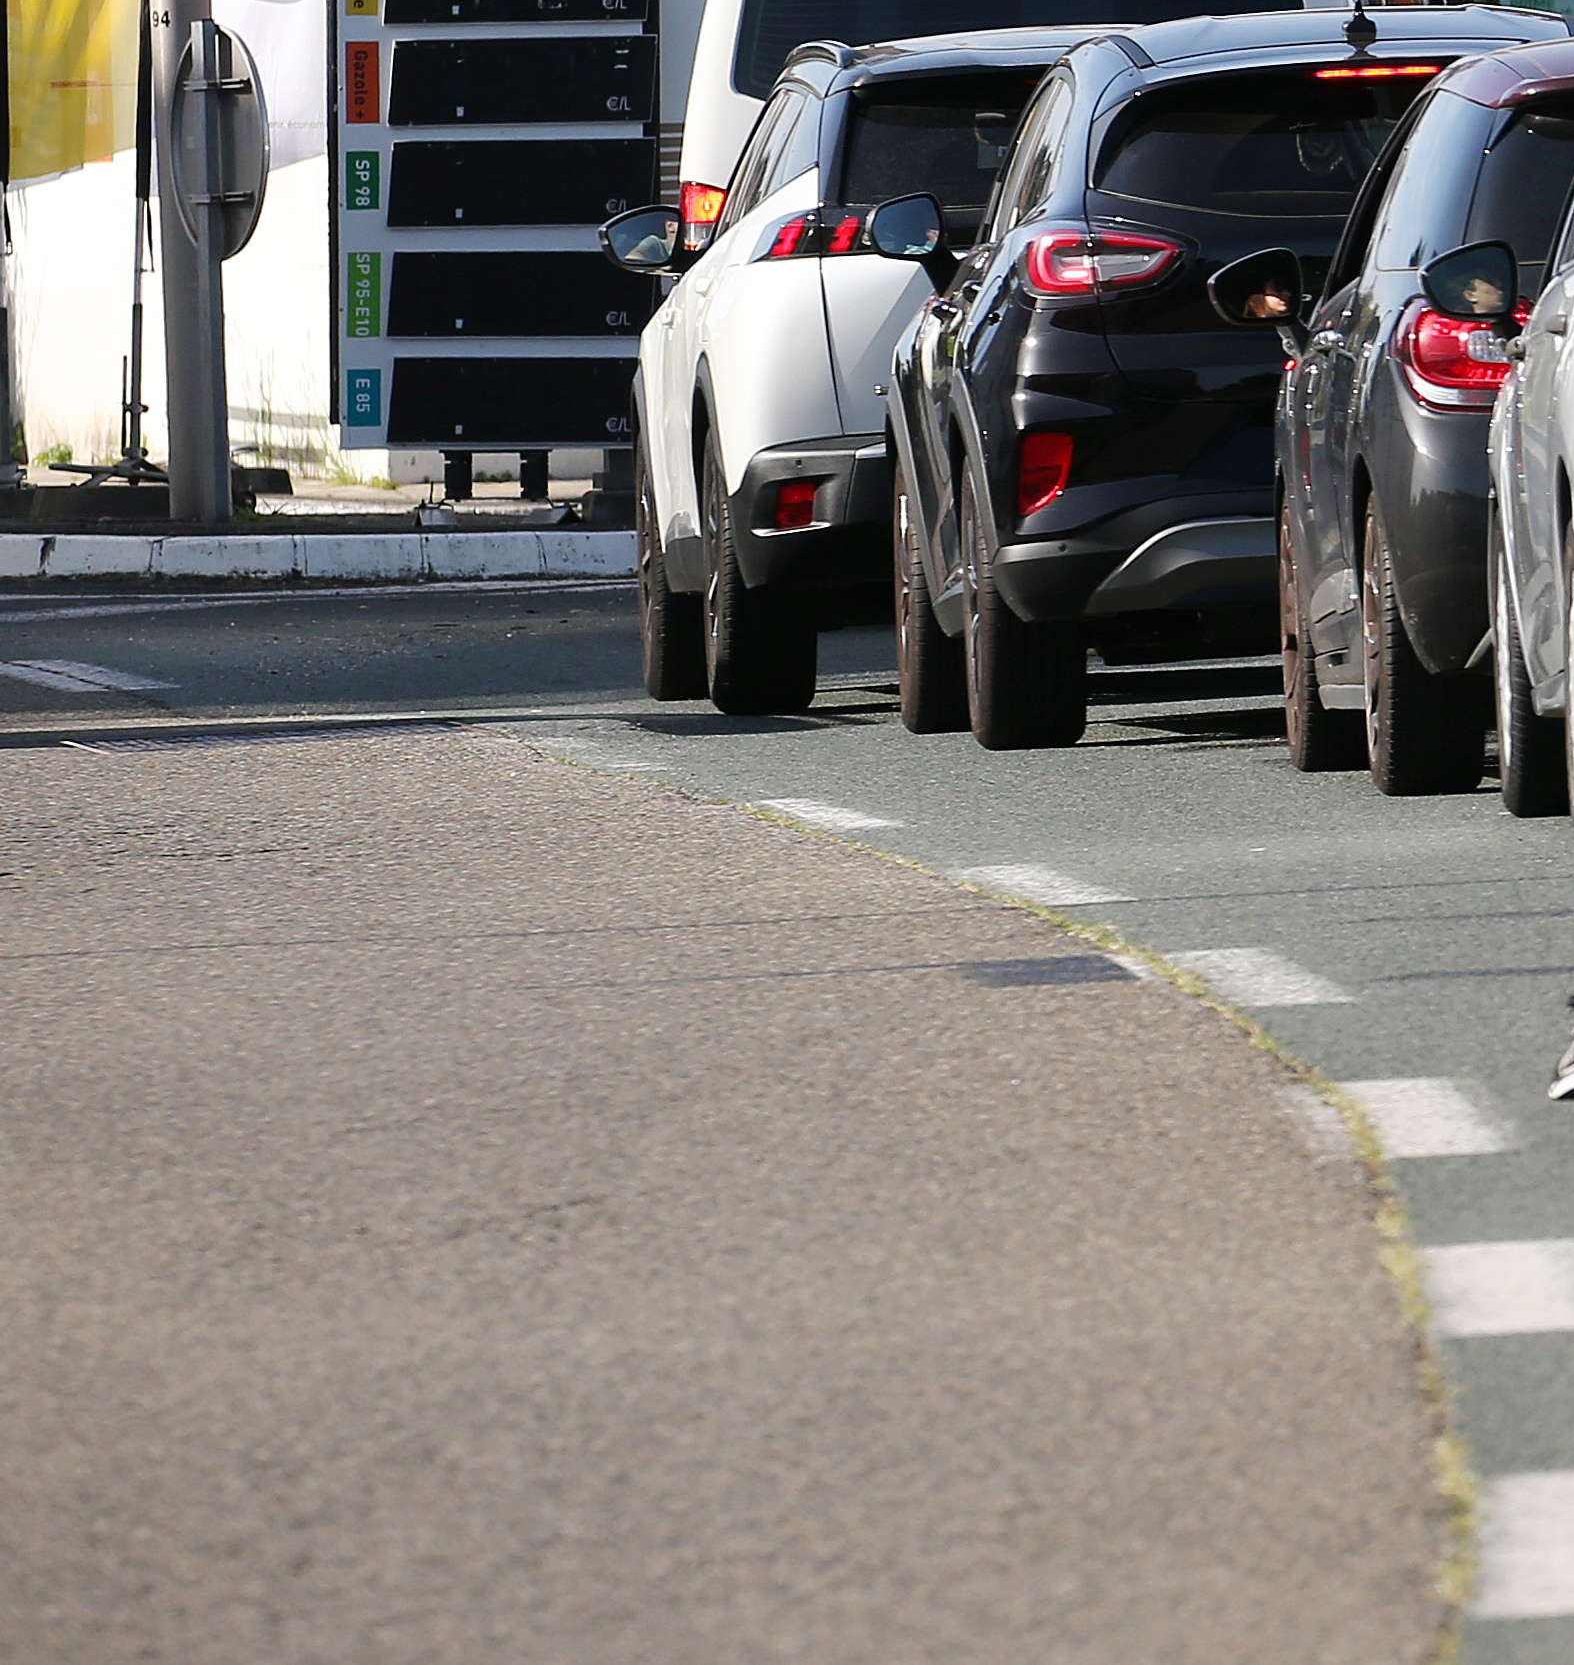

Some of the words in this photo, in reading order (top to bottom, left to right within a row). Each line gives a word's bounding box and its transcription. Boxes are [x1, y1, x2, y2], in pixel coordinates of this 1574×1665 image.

[153, 10, 170, 27] 94
[354, 50, 368, 105] Gazole
[606, 96, 631, 111] €/L
[356, 159, 370, 181] SP
[356, 186, 370, 207] 98
[356, 253, 370, 274] SP
[356, 279, 370, 336] 95-E10
[606, 311, 631, 326] €/L
[356, 378, 370, 388] E
[356, 392, 370, 413] 85
